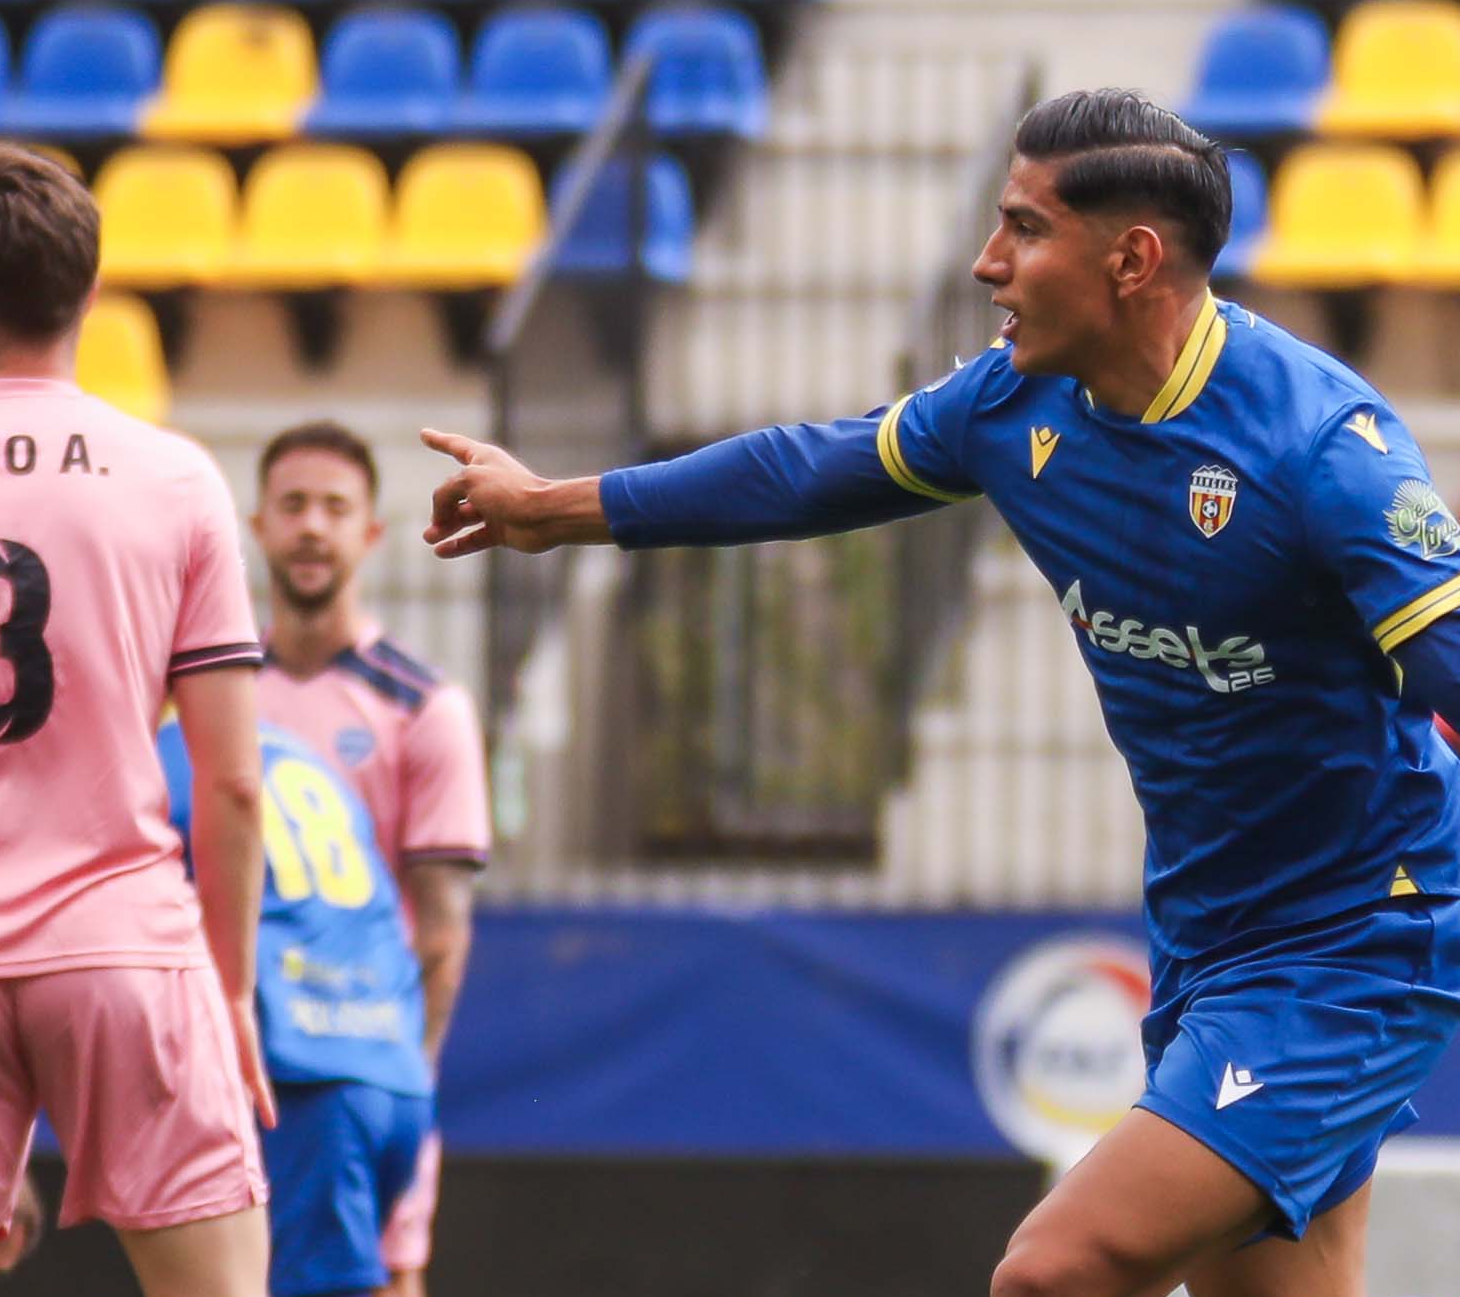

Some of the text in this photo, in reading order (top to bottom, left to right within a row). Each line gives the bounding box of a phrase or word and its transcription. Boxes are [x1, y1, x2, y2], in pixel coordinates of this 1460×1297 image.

[59, 433, 110, 476] A.
[1060, 578, 1266, 693] Assets
[262, 759, 374, 909] 18
